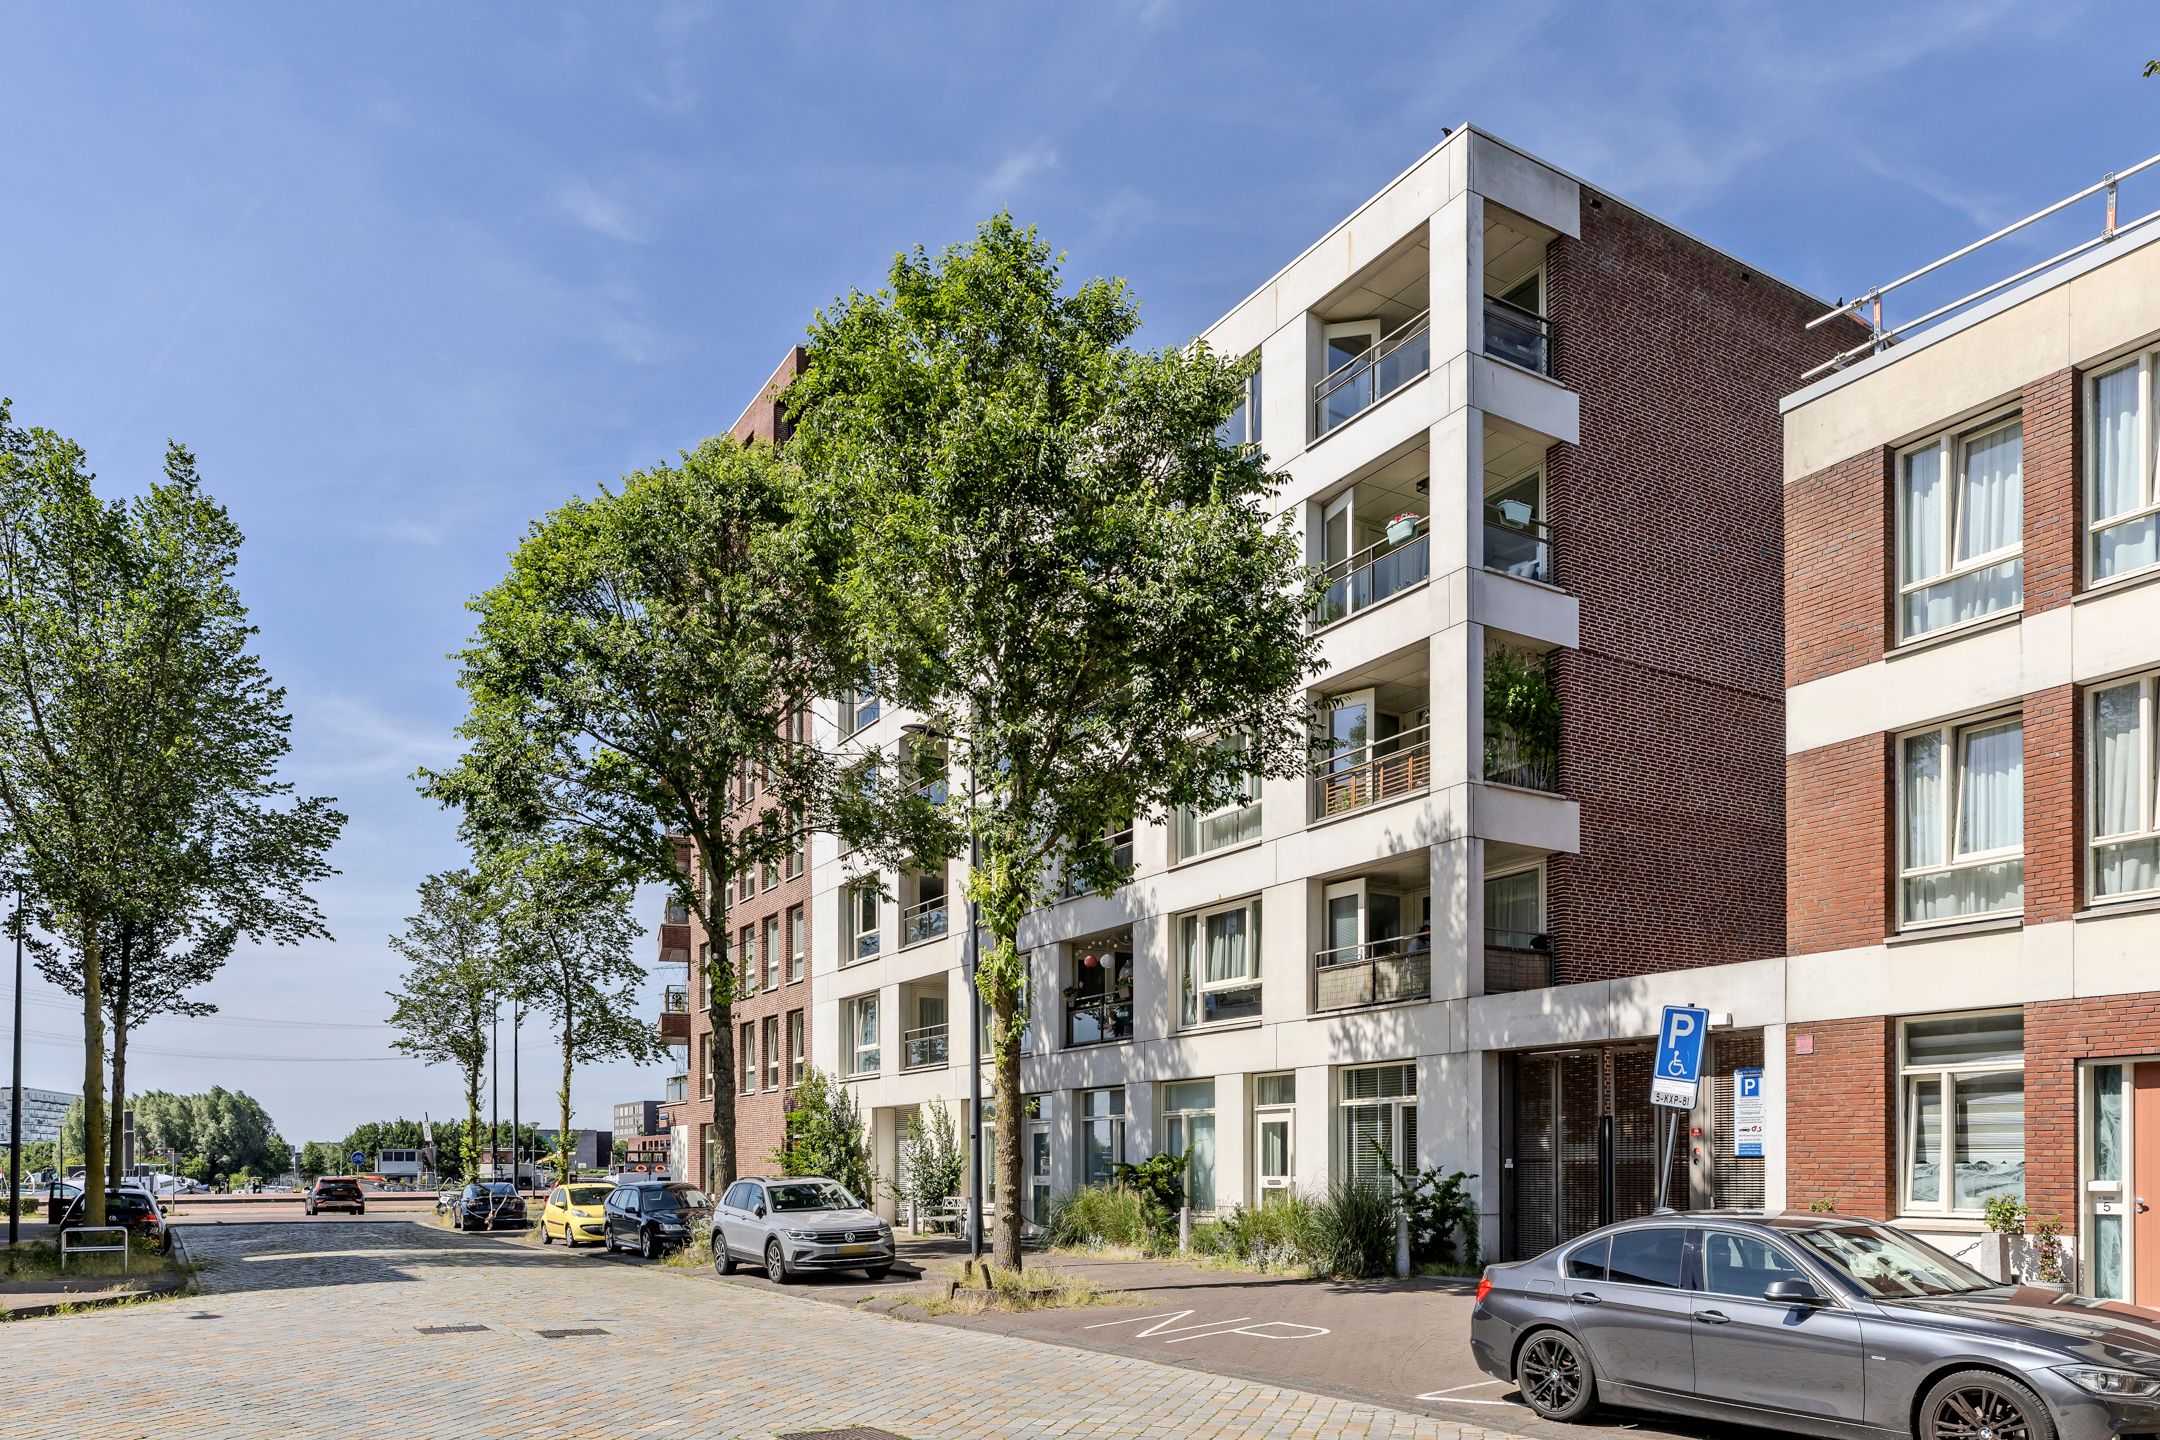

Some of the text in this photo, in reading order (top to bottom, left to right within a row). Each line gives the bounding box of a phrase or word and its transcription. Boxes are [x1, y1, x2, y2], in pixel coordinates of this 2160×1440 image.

[1668, 1013, 1695, 1049] P
[1744, 1078, 1756, 1096] P
[2103, 1201, 2111, 1212] 5
